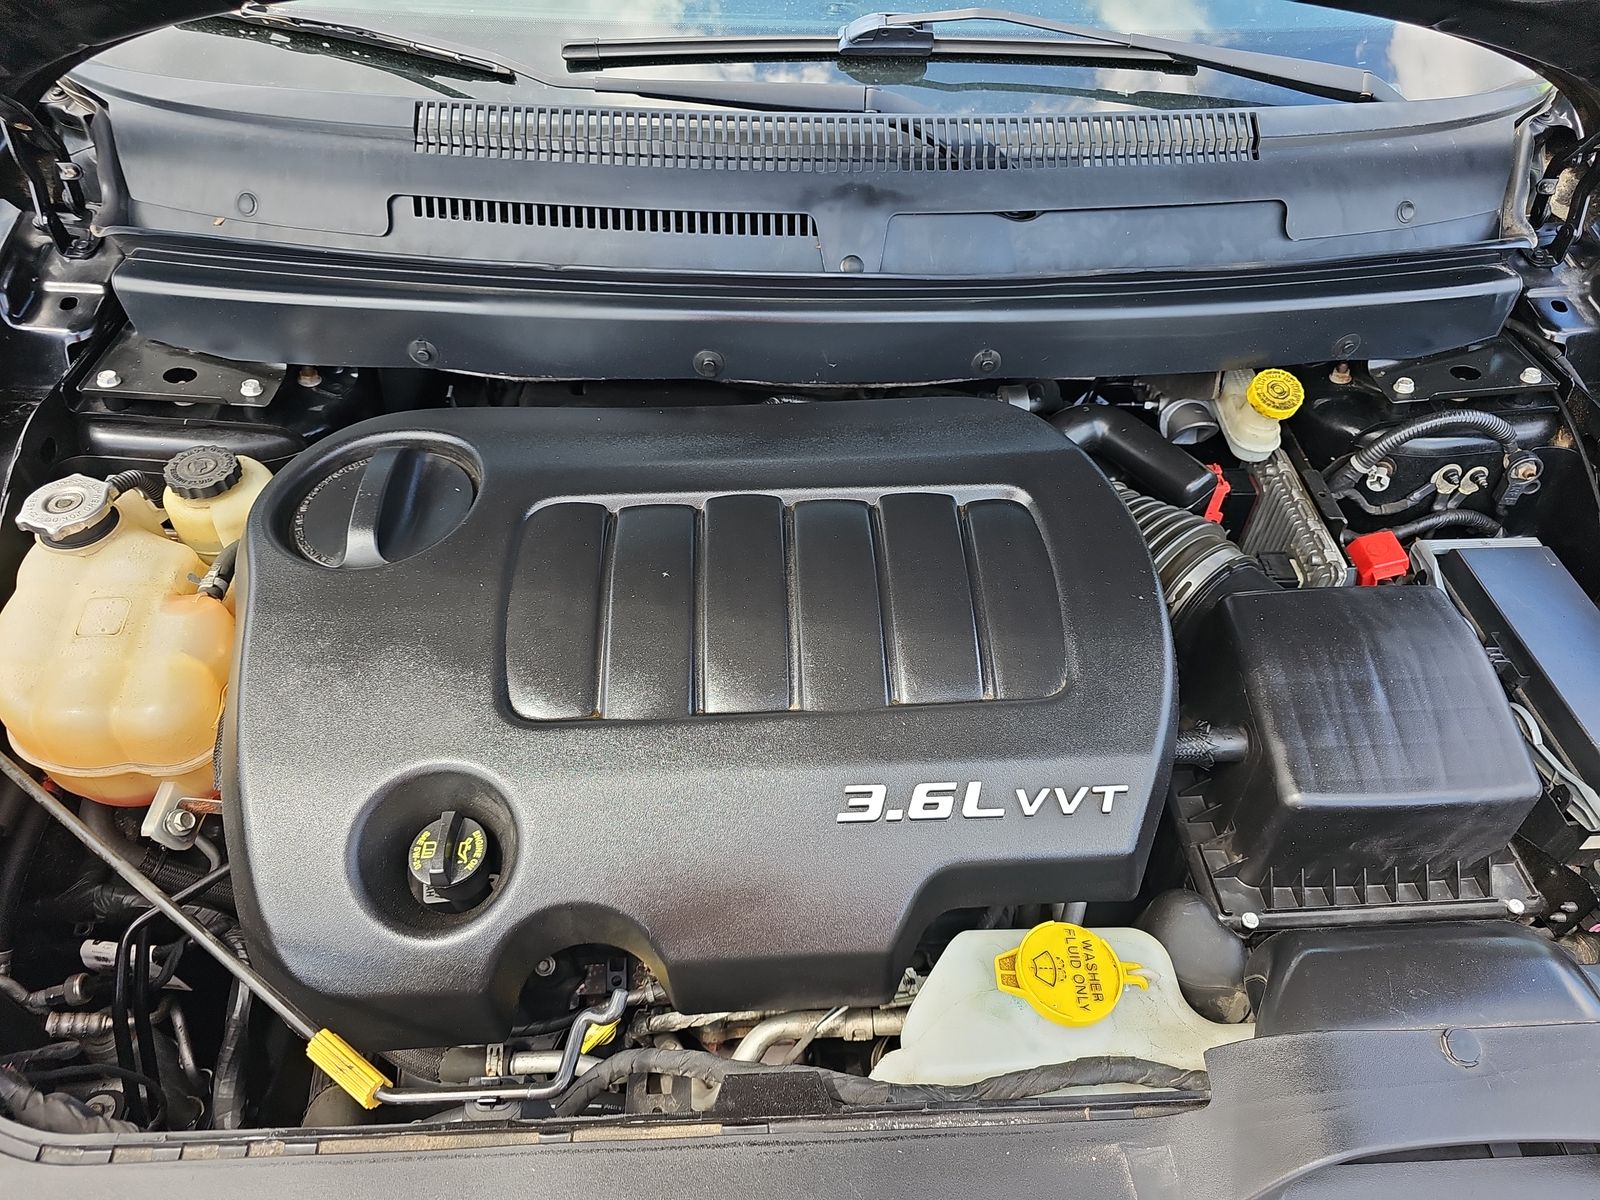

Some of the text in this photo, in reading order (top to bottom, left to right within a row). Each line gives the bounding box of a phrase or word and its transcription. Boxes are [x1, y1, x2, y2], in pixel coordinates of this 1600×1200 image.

[836, 781, 1129, 823] 3.6L VVT
[412, 831, 431, 870] SAE 5W-20
[463, 830, 484, 871] ENGINE OIL
[1064, 928, 1092, 1012] FLUID ONLY
[1081, 939, 1105, 1002] WASHER
